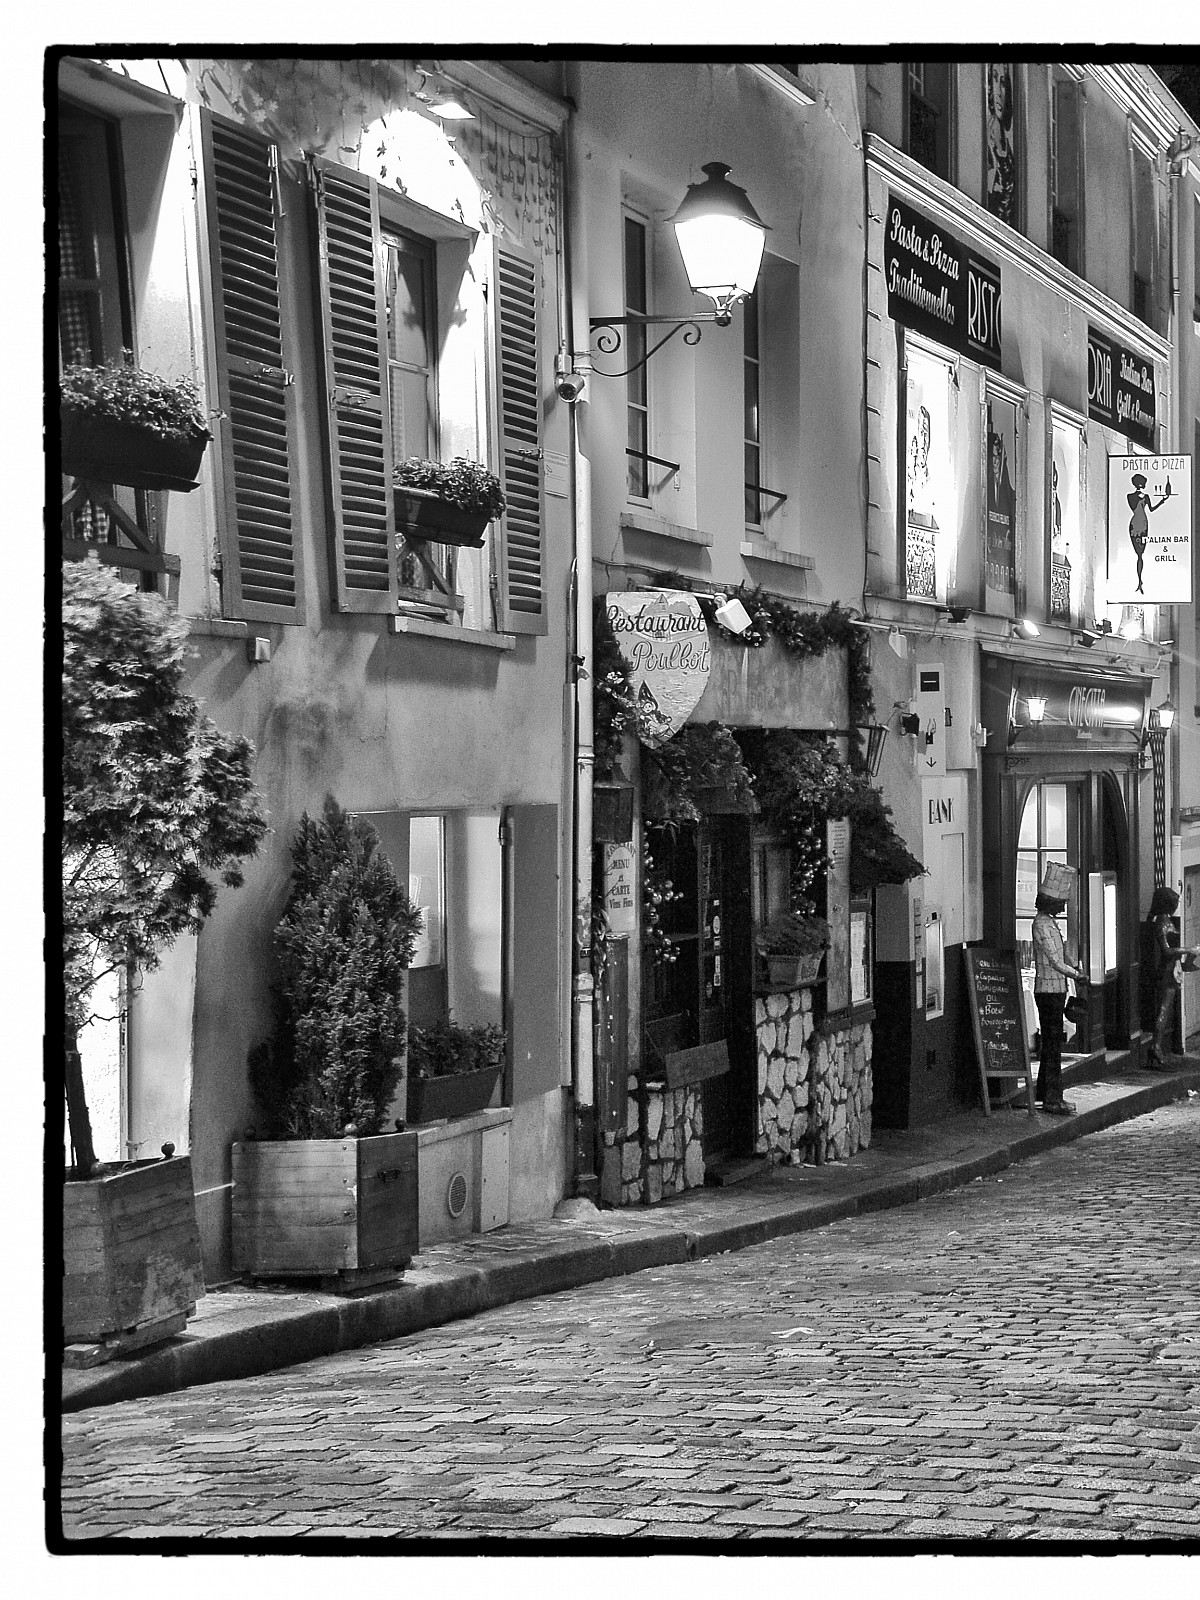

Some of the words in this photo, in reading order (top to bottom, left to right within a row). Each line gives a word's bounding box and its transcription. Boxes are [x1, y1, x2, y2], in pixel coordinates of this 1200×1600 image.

[890, 208, 922, 257] Pasta
[922, 240, 929, 262] &
[929, 234, 960, 281] Pizza
[888, 258, 955, 325] Traditionnelles
[1122, 459, 1149, 471] PASTA
[1161, 458, 1185, 470] PIZZA
[607, 604, 706, 632] Restaurant
[631, 641, 711, 672] Poulbot
